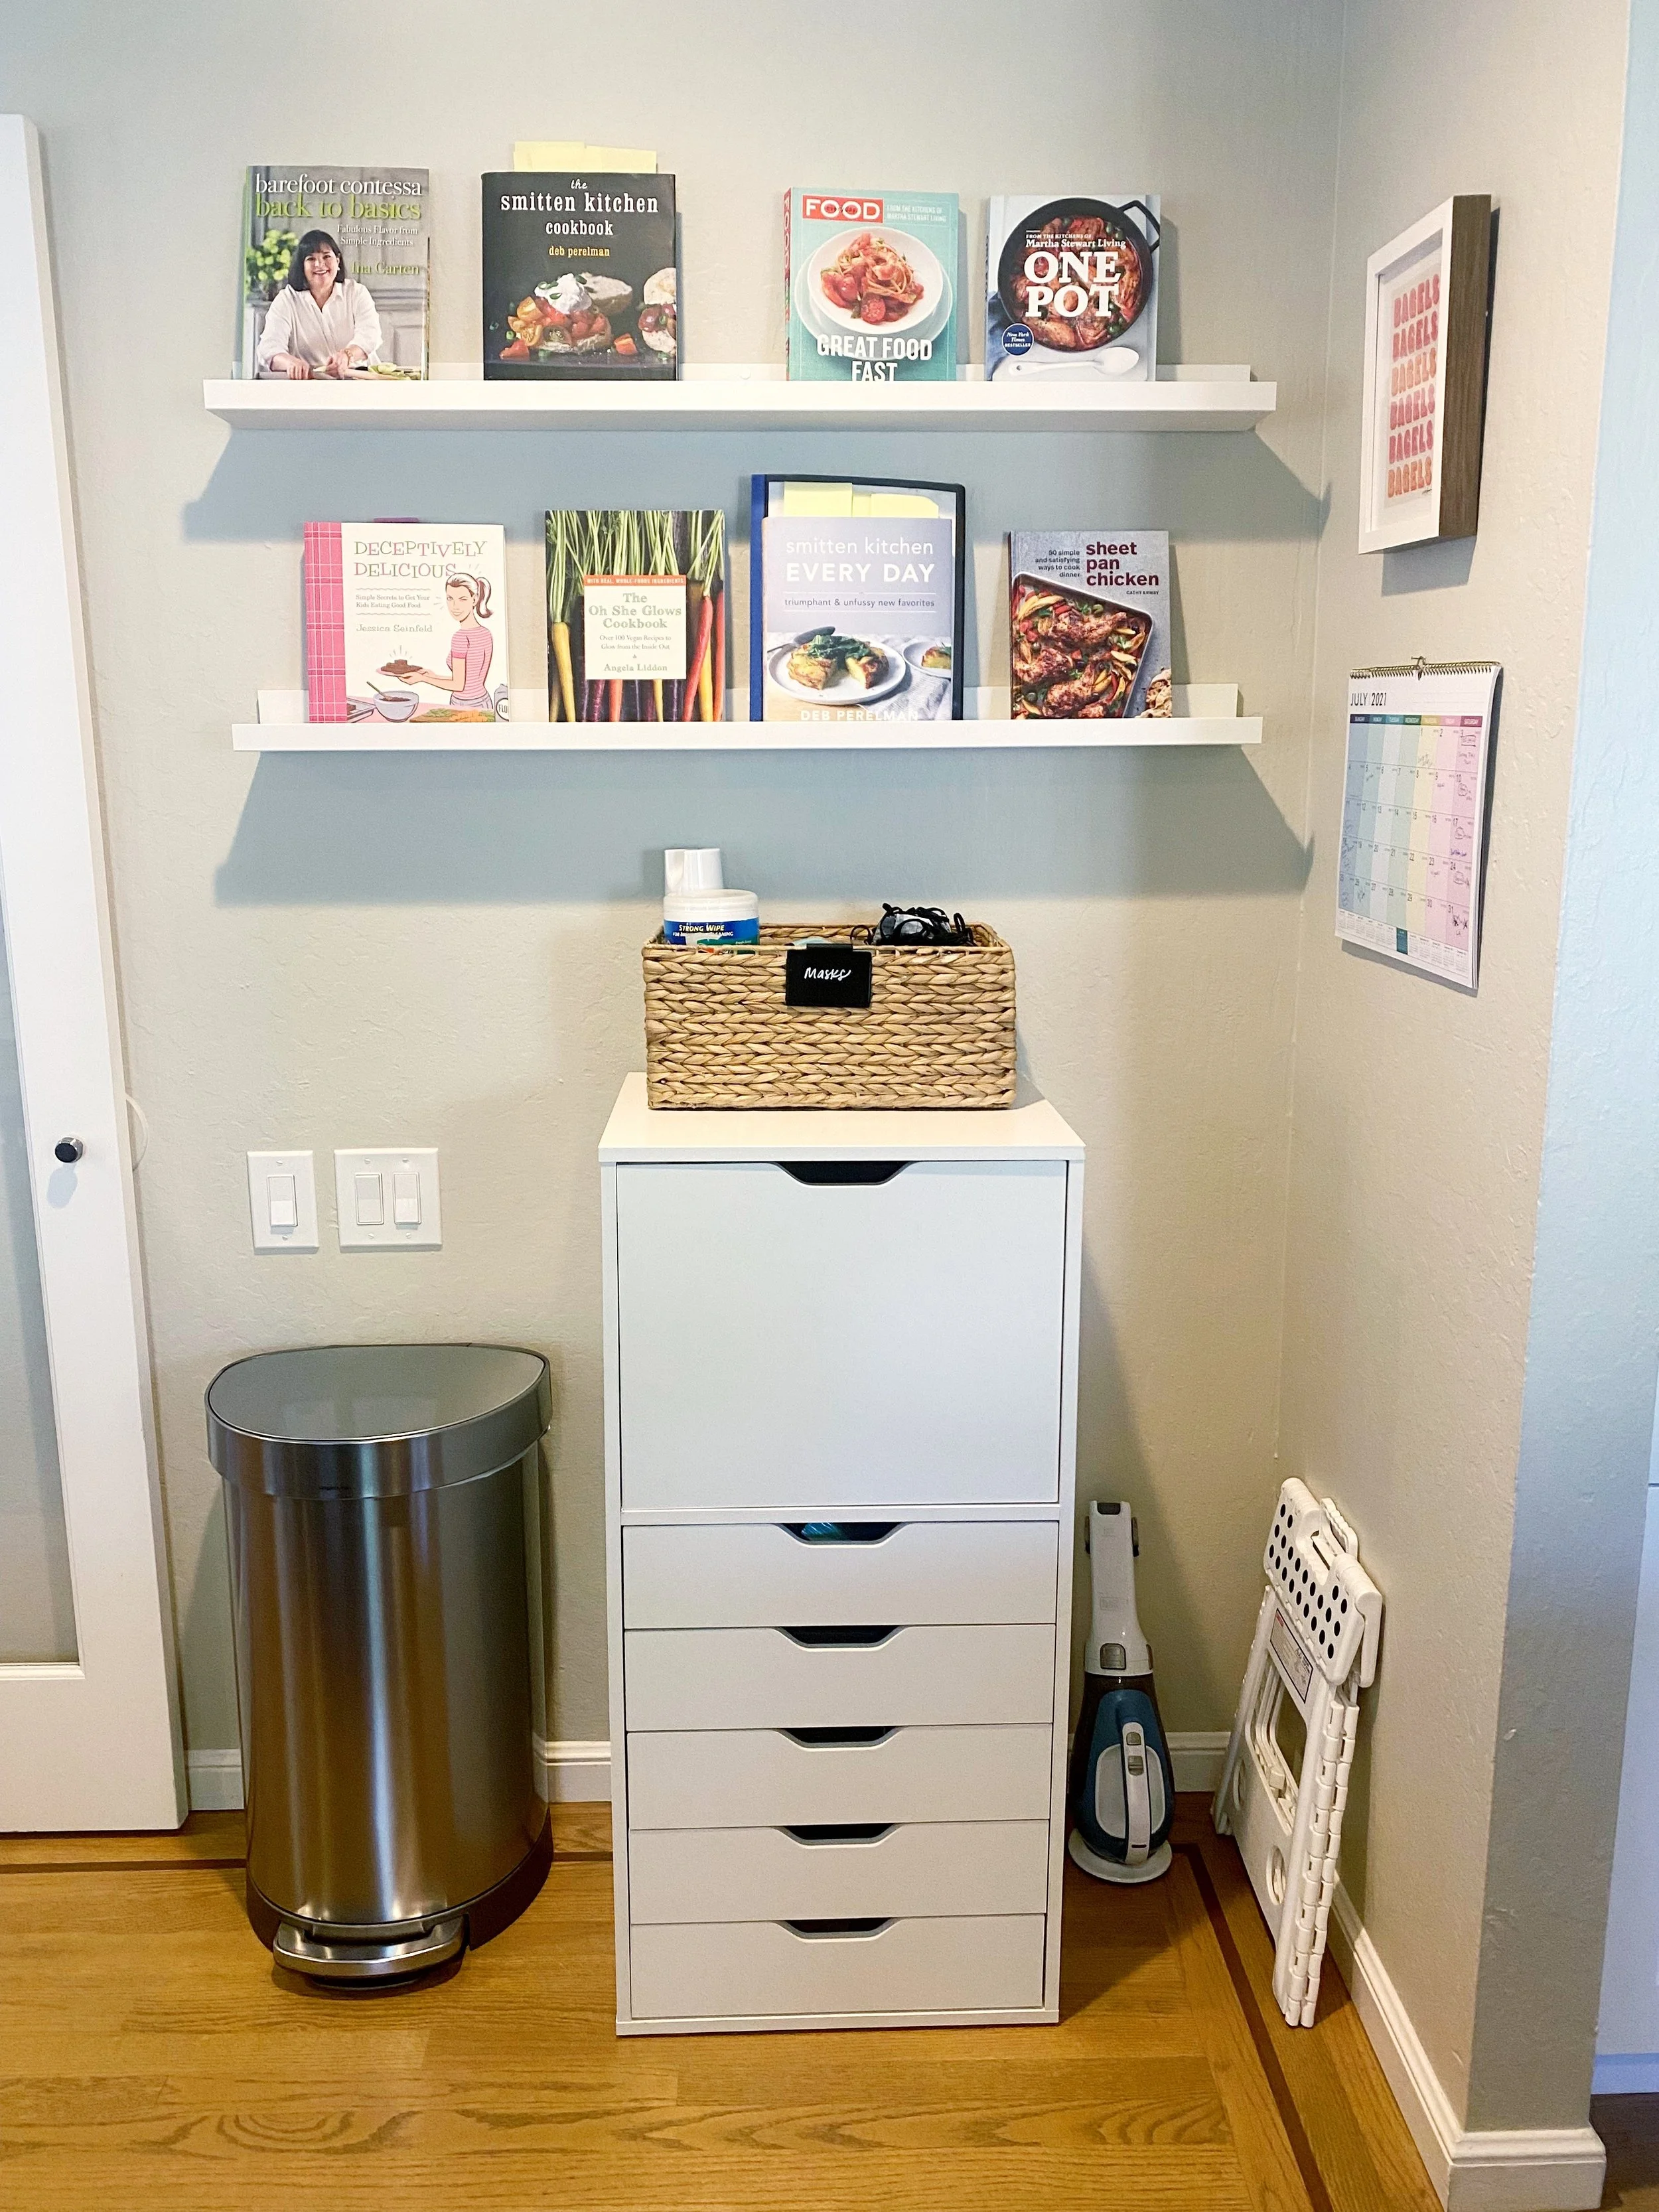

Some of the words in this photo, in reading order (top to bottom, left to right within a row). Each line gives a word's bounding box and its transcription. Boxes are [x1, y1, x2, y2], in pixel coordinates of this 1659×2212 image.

[255, 173, 334, 193] barefoot
[340, 179, 422, 196] contessa
[571, 179, 588, 190] the
[255, 192, 313, 218] back
[320, 197, 342, 218] to
[350, 193, 421, 220] basics
[500, 192, 576, 212] smitten
[584, 192, 658, 213] kitchen
[806, 198, 881, 220] FOOD
[337, 224, 372, 234] Fabulous
[374, 225, 397, 234] Flavor
[399, 226, 418, 234] from
[545, 220, 614, 236] cookbook
[341, 236, 367, 247] Simple
[369, 237, 413, 247] Ingredients
[1026, 239, 1059, 248] Martha
[1061, 239, 1096, 248] Stewart
[1098, 239, 1126, 250] Living
[549, 246, 565, 256] deb
[567, 246, 610, 258] perelman
[352, 261, 372, 274] Ina
[376, 261, 420, 275] Garten
[1024, 250, 1121, 283] ONE
[1025, 284, 1119, 317] POT
[1394, 273, 1439, 328] BAGELS
[1393, 311, 1438, 362] BAGELS
[817, 334, 878, 358] GREAT
[882, 338, 932, 360] FOOD
[851, 361, 898, 381] FAST
[1392, 347, 1437, 396] BAGELS
[1390, 383, 1435, 430] BAGELS
[1389, 419, 1433, 464] BAGELS
[1388, 456, 1432, 498] BAGELS
[354, 540, 487, 557] DECEPTIVELY
[786, 538, 857, 554] smitten
[865, 536, 933, 555] kitchen
[1086, 542, 1137, 555] sheet
[354, 562, 457, 579] DELICIOUS
[786, 563, 871, 582] EVERY
[883, 563, 935, 583] DAY
[1086, 559, 1120, 573] pan
[1086, 571, 1159, 586] chicken
[622, 593, 648, 603] The
[784, 598, 831, 607] triumphant
[843, 598, 875, 608] unfussy
[589, 605, 607, 616] Oh
[612, 605, 637, 616] She
[642, 605, 682, 616] Glows
[603, 617, 668, 628] Cookbook
[604, 664, 634, 673] Angela
[1350, 693, 1367, 706] JULY
[1371, 692, 1387, 706] 2021
[800, 710, 830, 720] DEB
[837, 710, 918, 721] PERELMAN
[1456, 774, 1461, 782] 10
[1453, 818, 1459, 827] 17
[1409, 852, 1415, 861] 22
[1429, 857, 1435, 866] 23
[1450, 861, 1456, 871] 24
[1448, 905, 1453, 914] 31
[804, 966, 851, 981] Masks
